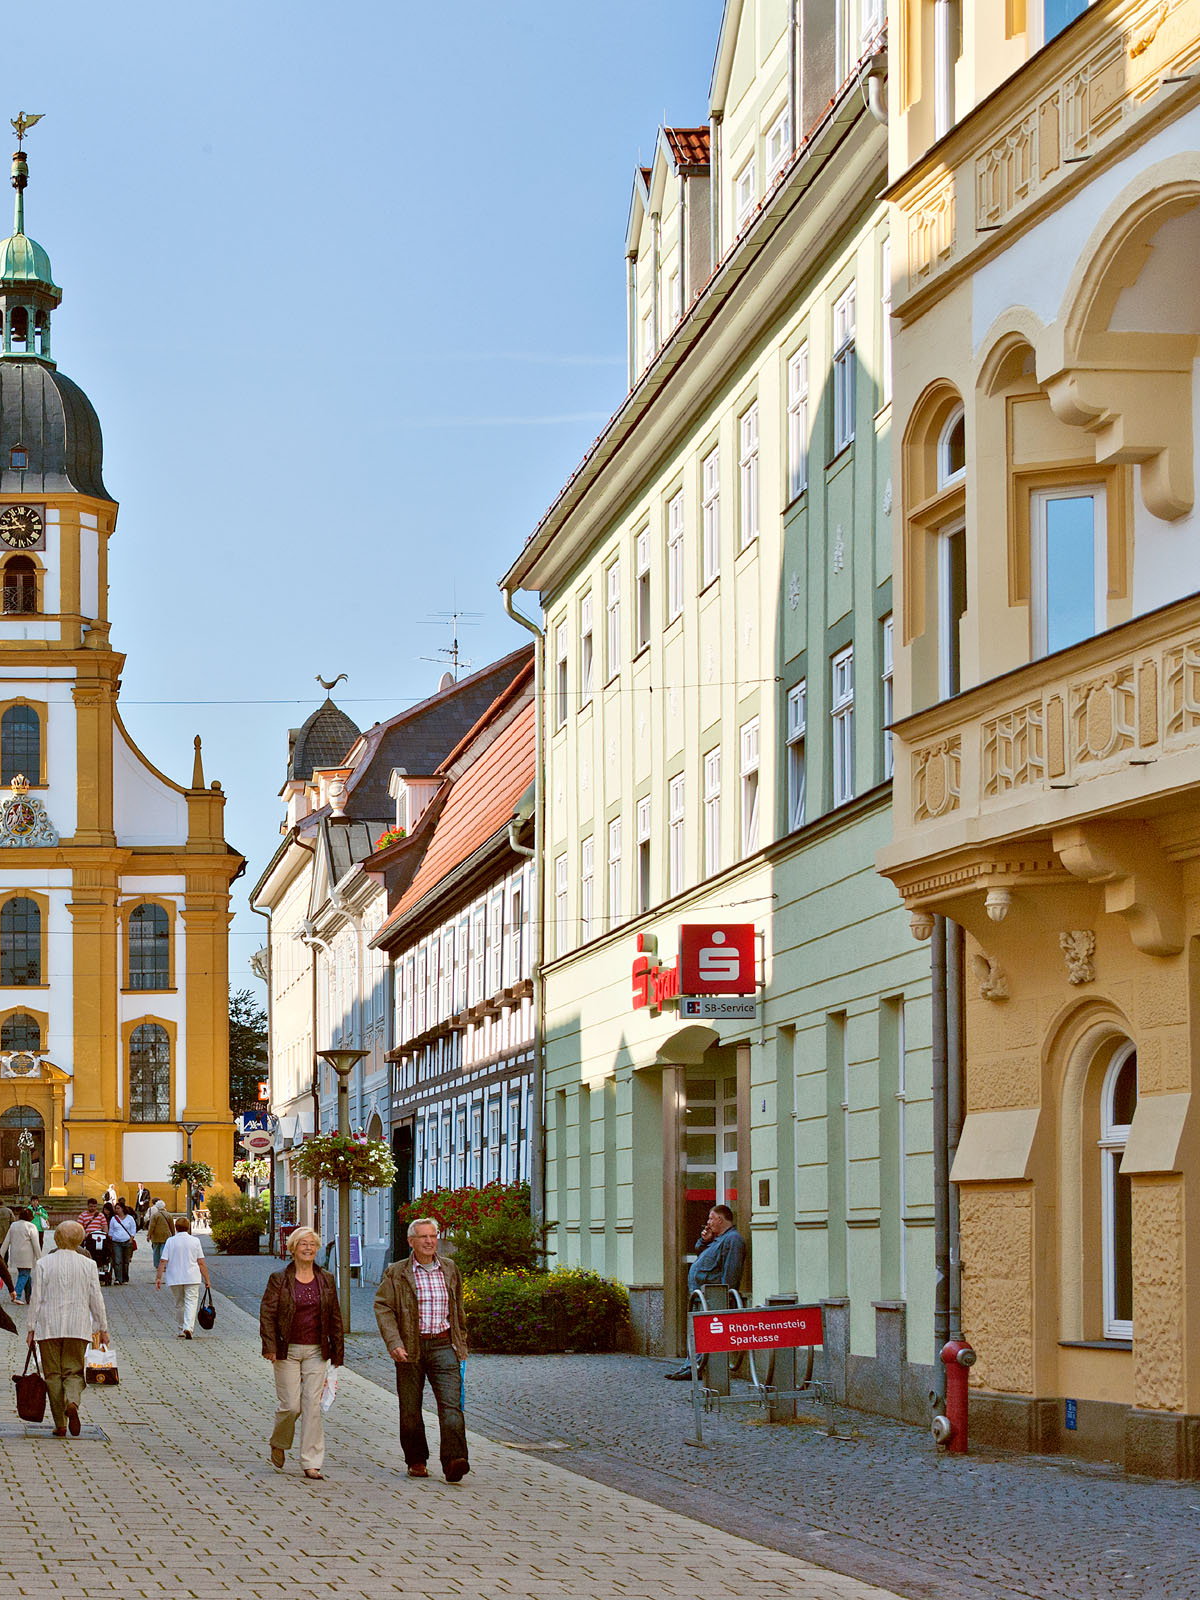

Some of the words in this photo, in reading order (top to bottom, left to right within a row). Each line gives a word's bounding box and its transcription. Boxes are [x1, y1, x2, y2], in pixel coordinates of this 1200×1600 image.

[704, 1003, 754, 1013] SB-Service
[728, 1319, 806, 1333] Rhön-Rennsteig
[729, 1334, 780, 1346] Sparkasse
